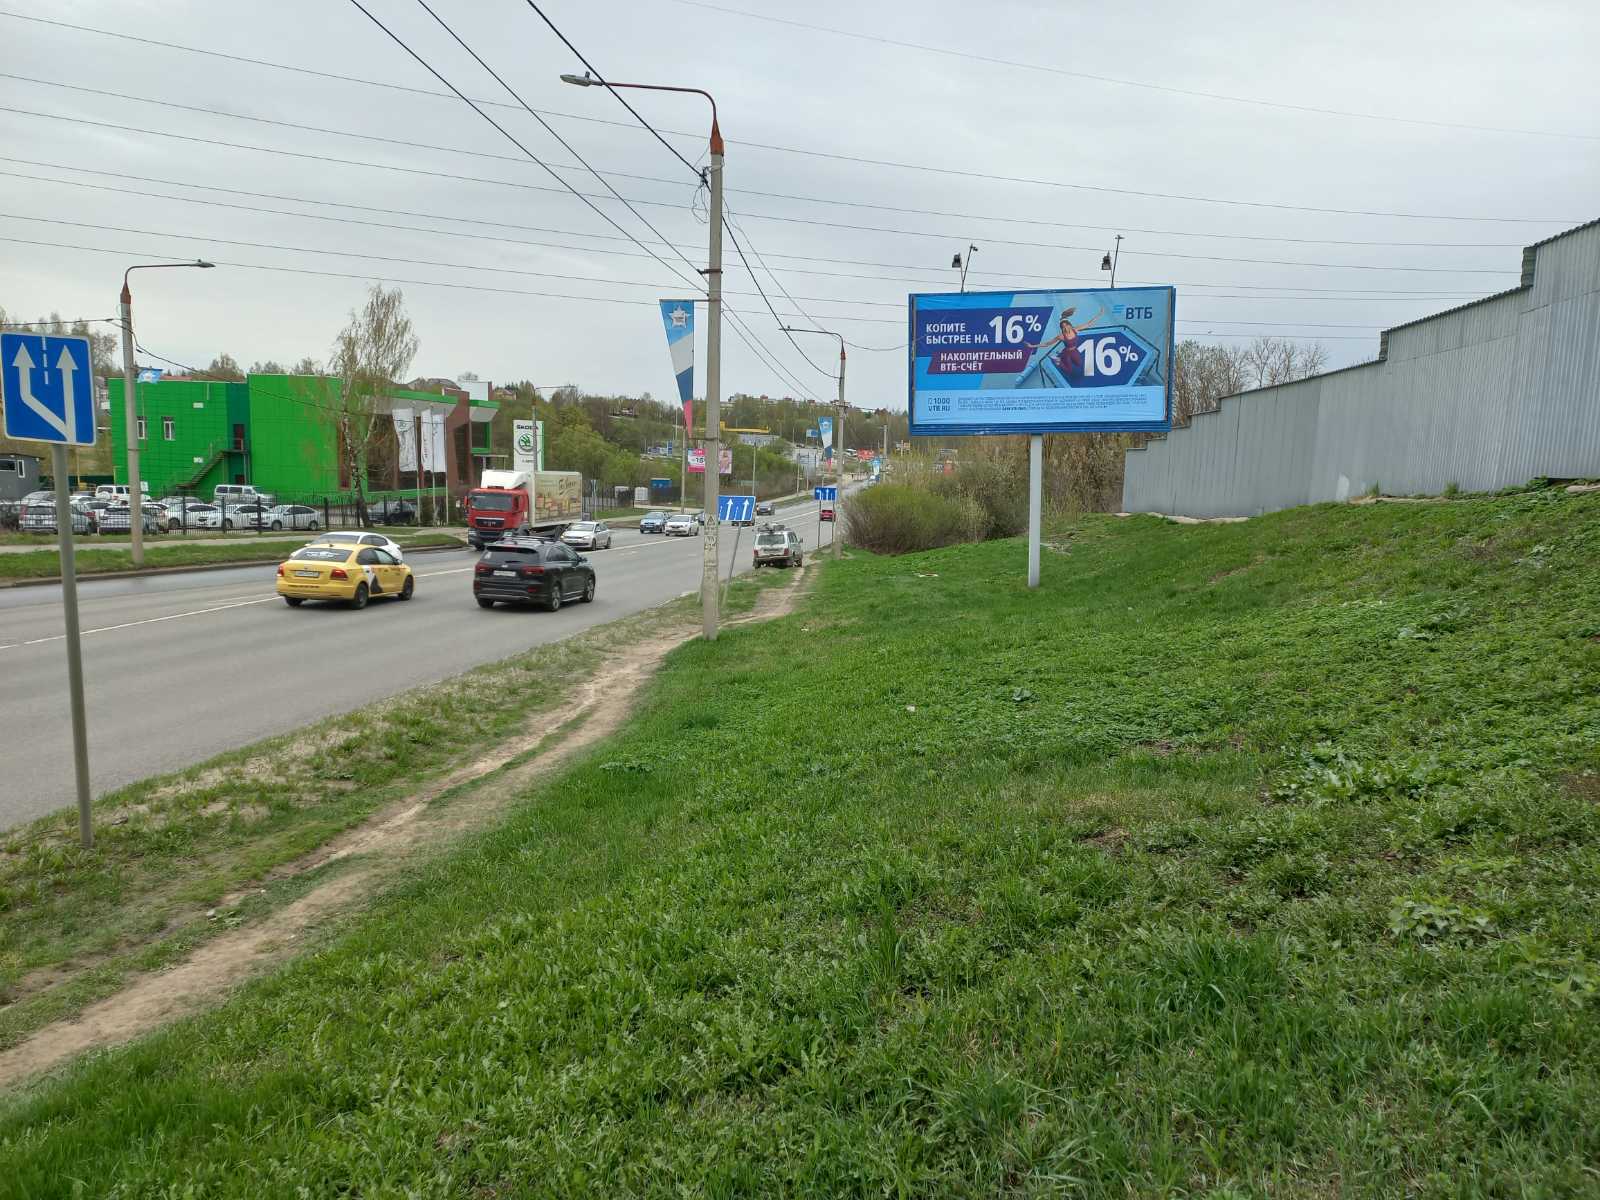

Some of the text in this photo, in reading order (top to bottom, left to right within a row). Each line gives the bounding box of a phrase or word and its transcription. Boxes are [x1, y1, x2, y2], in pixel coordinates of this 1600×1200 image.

[1125, 306, 1153, 320] ВТБ
[926, 323, 966, 333] КОПИТЕ
[989, 315, 1042, 345] 16%
[926, 334, 989, 345] БЫСТРЕЕ НА
[940, 349, 1023, 361] НАКОПИТЕЛЬНЫЙ
[1076, 336, 1139, 377] 16%
[940, 362, 984, 372] ВТБ-СЧЁТ
